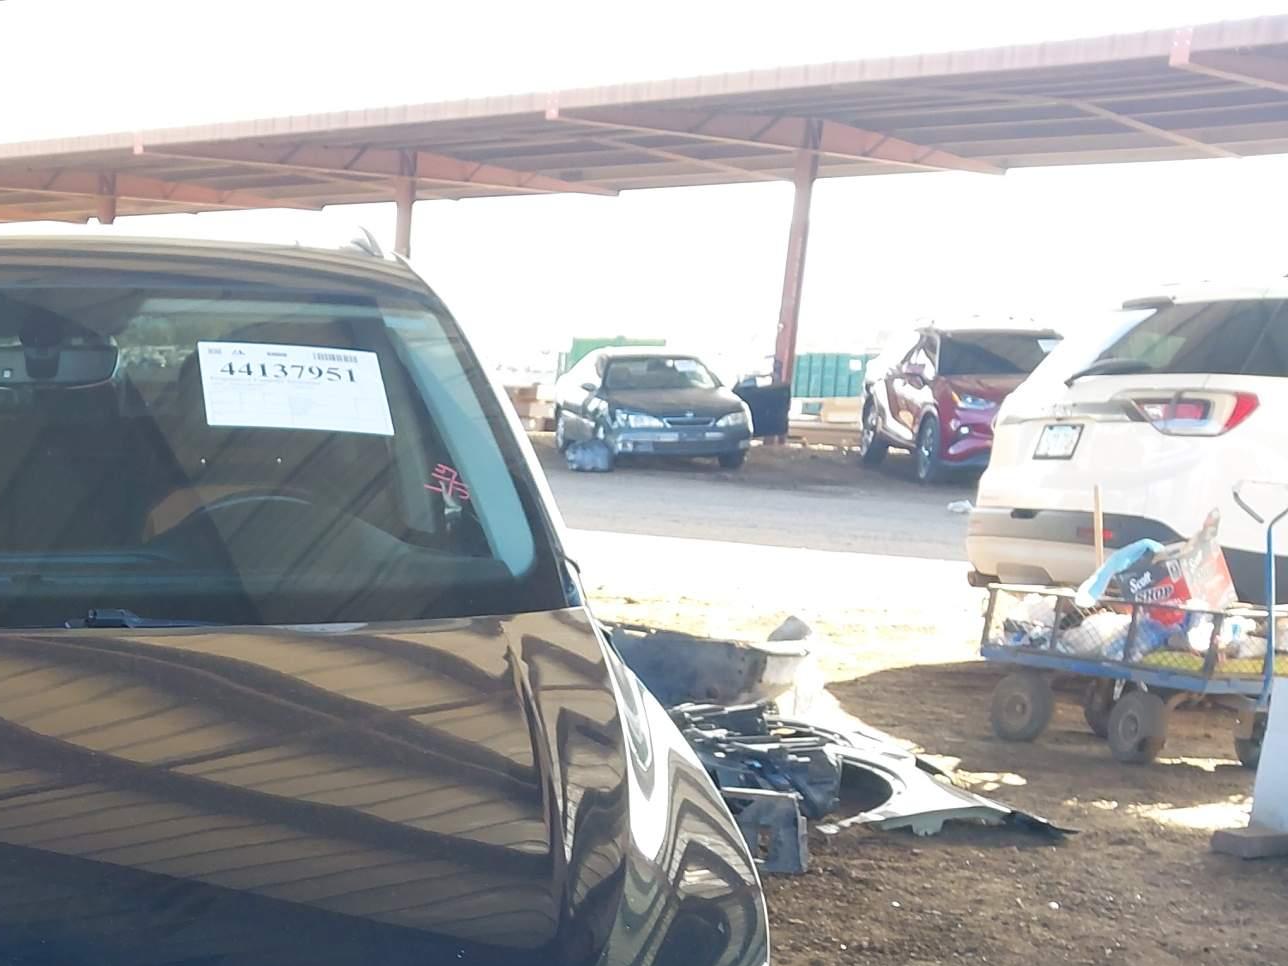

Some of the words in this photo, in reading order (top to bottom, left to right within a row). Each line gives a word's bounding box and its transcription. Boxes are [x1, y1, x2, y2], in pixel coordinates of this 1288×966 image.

[220, 361, 355, 383] 44137951
[1129, 571, 1152, 594] Scott
[1135, 584, 1174, 603] SHOP
